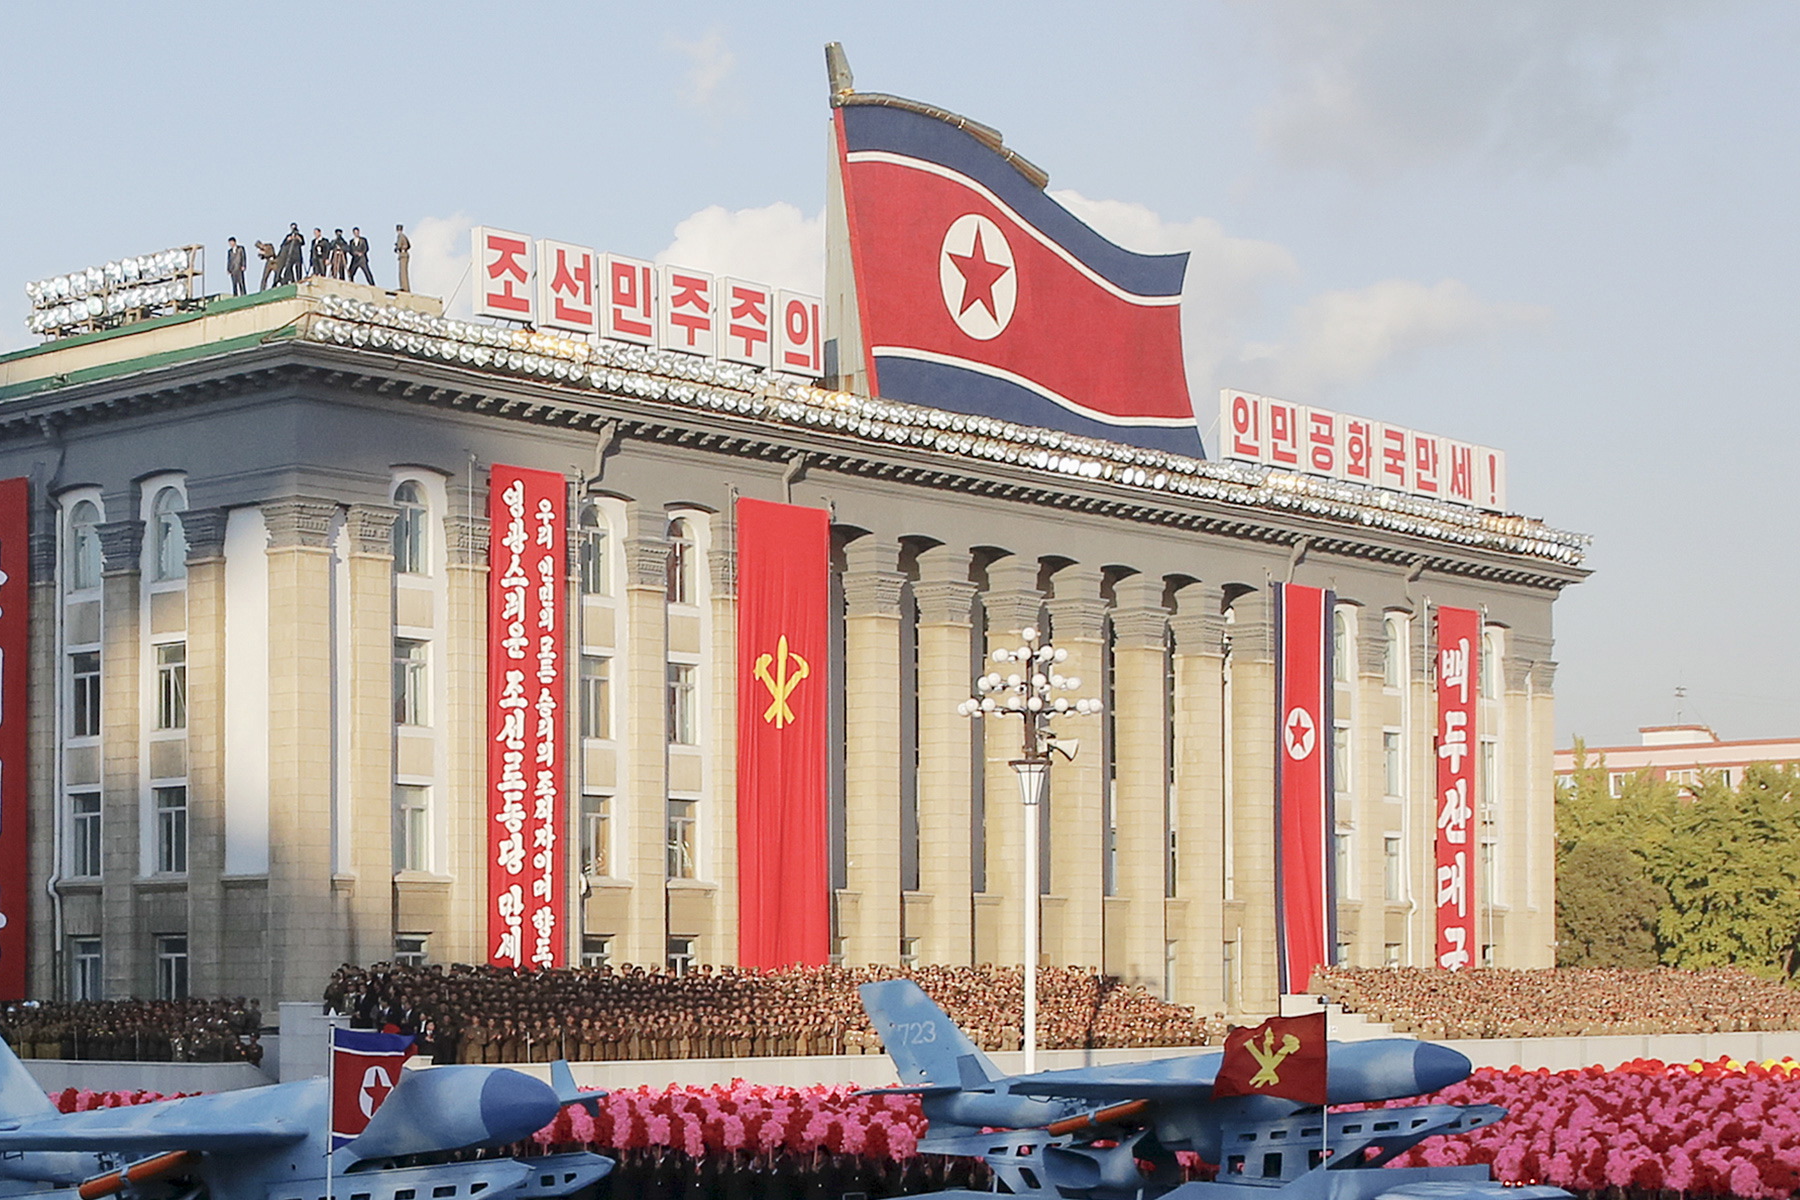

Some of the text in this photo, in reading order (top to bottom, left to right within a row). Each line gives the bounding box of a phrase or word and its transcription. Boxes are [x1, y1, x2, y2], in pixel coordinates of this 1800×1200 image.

[486, 234, 820, 372] 조선민주주의
[1231, 396, 1497, 505] 인민공화국만세!
[500, 479, 530, 660] 영광스러운
[495, 669, 528, 875] 조선로동당
[531, 497, 558, 969] 우리 인민의 모든 승리의 조직자이며 향도
[897, 1021, 936, 1046] 723
